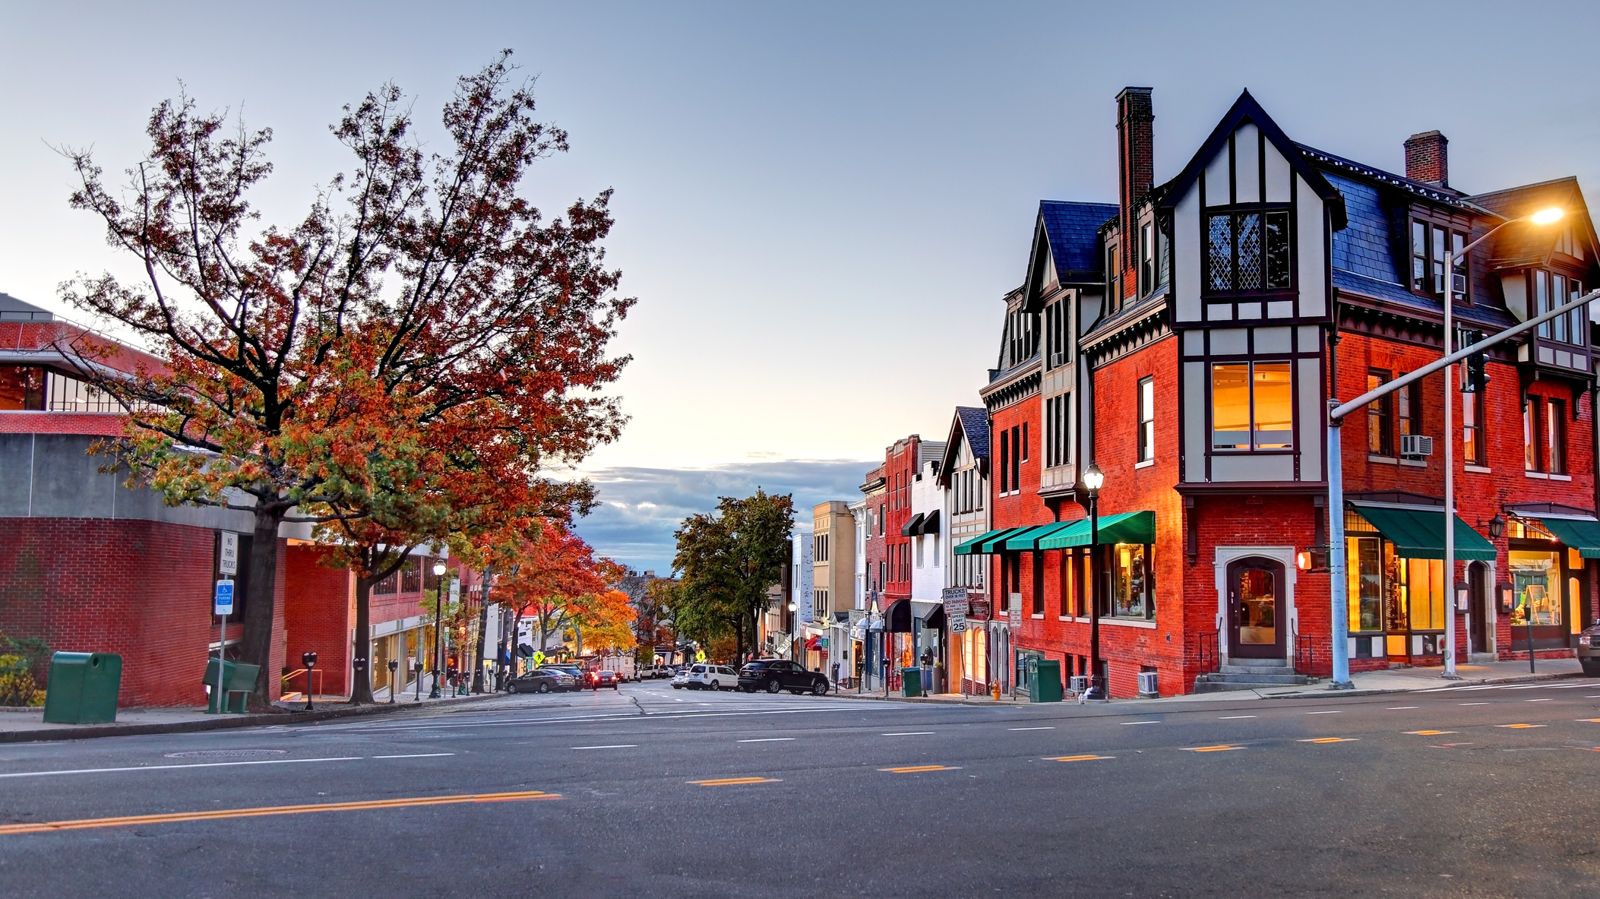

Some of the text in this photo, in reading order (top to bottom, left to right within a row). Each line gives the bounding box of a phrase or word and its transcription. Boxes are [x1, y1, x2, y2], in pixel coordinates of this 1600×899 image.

[227, 537, 233, 546] NO
[223, 559, 236, 569] TRUCKS
[953, 622, 965, 631] 25
